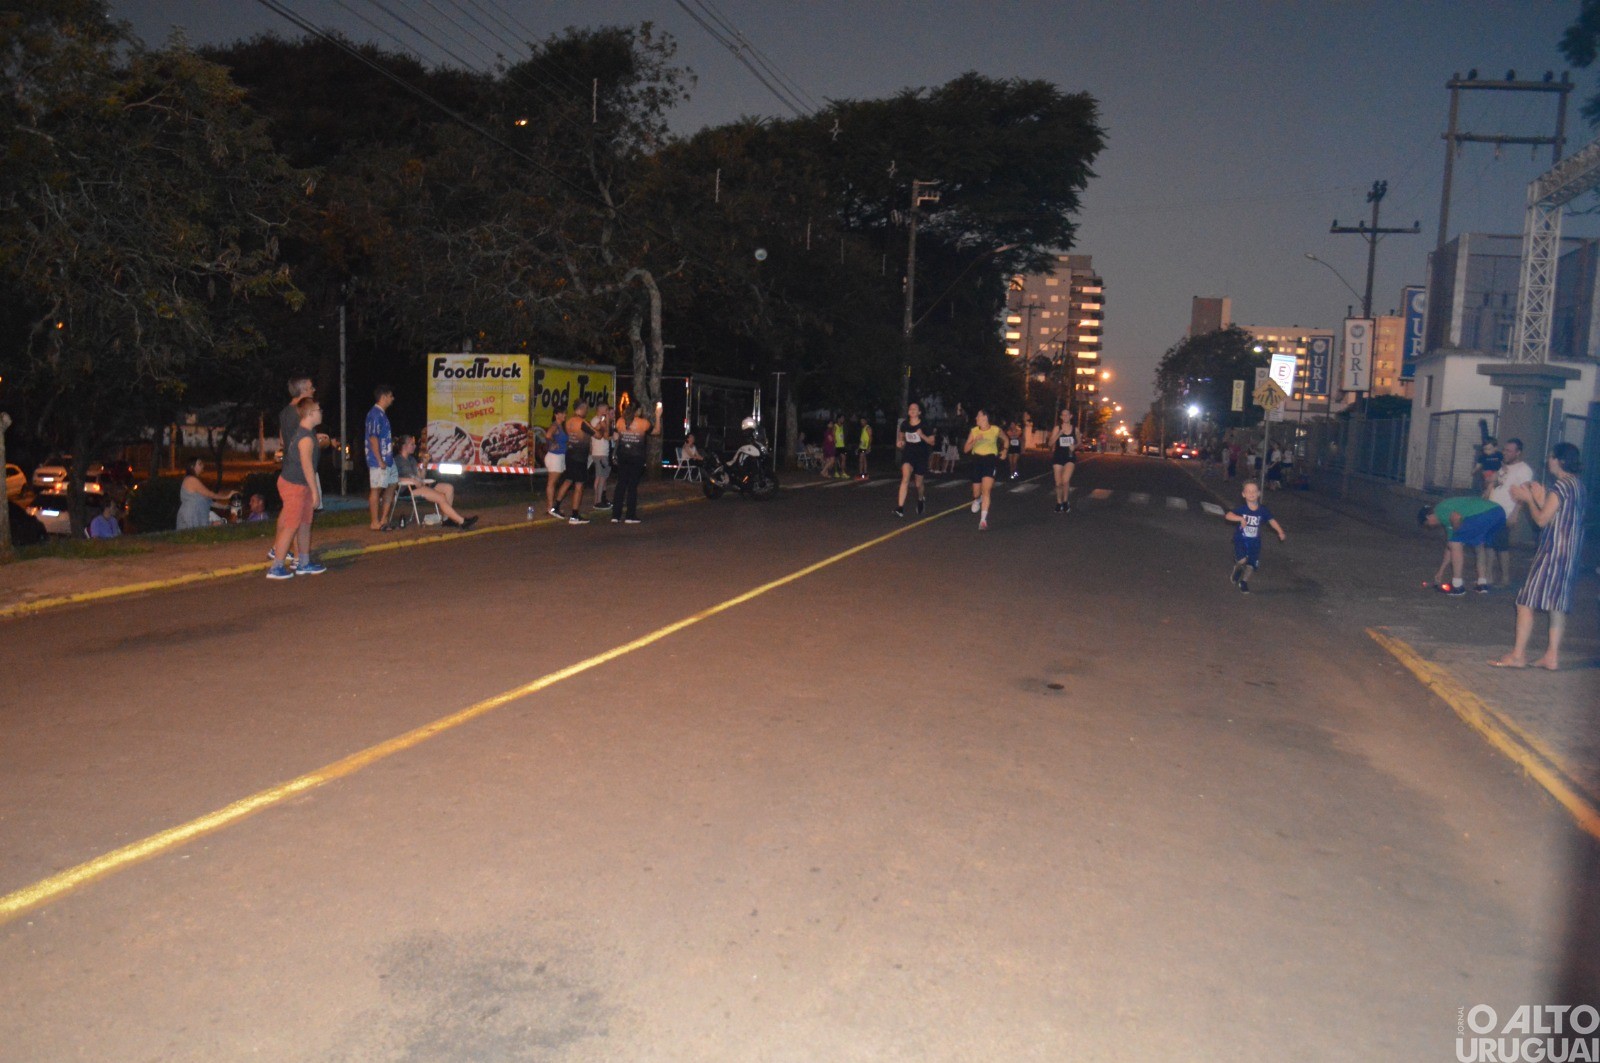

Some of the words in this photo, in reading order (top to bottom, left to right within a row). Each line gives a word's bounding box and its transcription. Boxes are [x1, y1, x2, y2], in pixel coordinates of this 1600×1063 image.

[1312, 355, 1325, 392] URI
[1350, 342, 1364, 386] URI
[456, 399, 481, 411] TUDO
[482, 395, 496, 406] NO
[533, 368, 571, 409] Food
[577, 374, 609, 408] Truck
[465, 406, 495, 420] ESPETO
